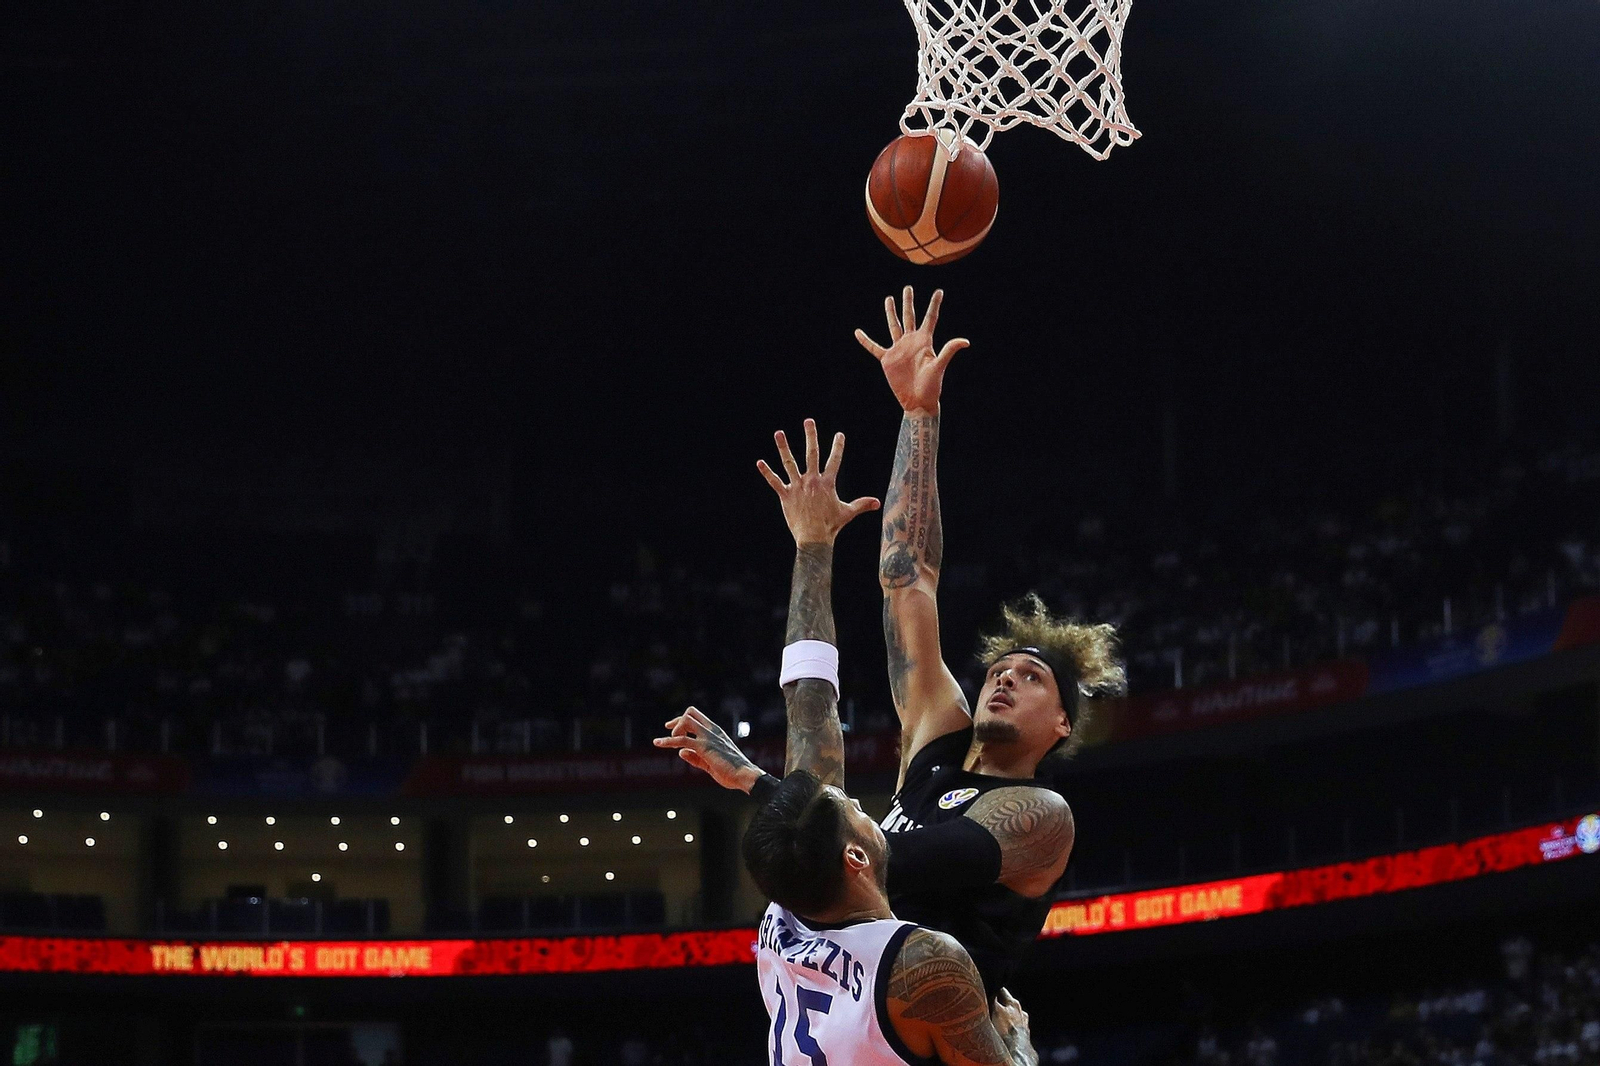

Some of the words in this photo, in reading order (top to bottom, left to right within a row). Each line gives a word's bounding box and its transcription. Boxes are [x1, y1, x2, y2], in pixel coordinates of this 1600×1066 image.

[911, 438, 920, 468] STAND
[910, 471, 919, 503] BEFORE
[917, 528, 926, 549] GOD
[1134, 894, 1175, 922] GOT
[1179, 884, 1243, 915] GAME
[150, 945, 194, 970] THE
[200, 942, 306, 971] WORLD'S
[315, 947, 357, 970] GOT
[364, 946, 432, 970] GAME
[774, 975, 834, 1066] 15
